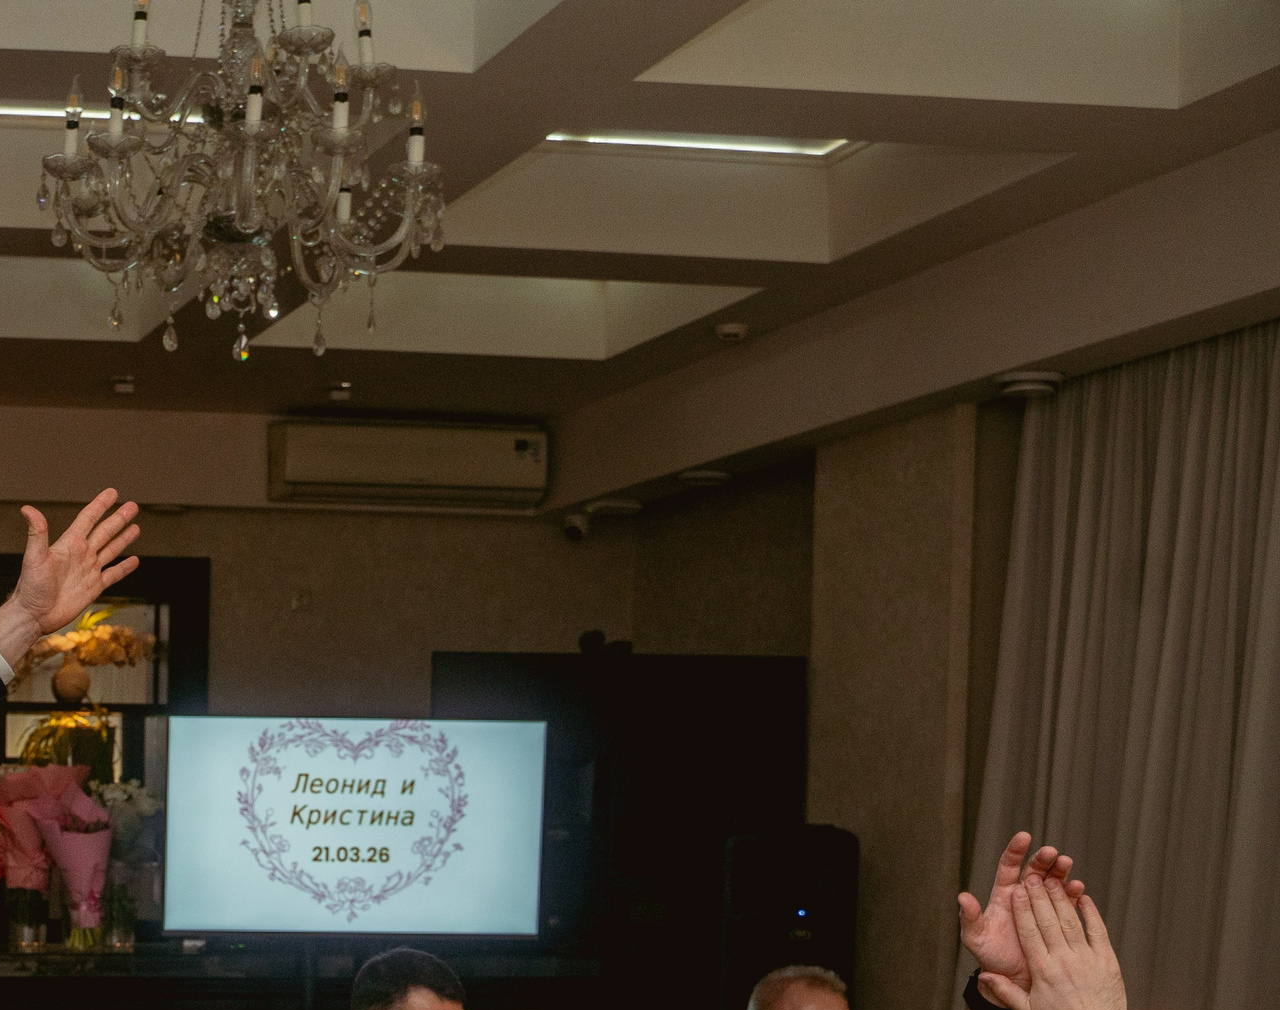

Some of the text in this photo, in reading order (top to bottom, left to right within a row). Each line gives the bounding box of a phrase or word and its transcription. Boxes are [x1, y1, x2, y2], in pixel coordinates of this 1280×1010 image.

[291, 773, 416, 797] Леонид и
[290, 804, 416, 830] Кристина
[312, 846, 390, 863] 21.03.26
